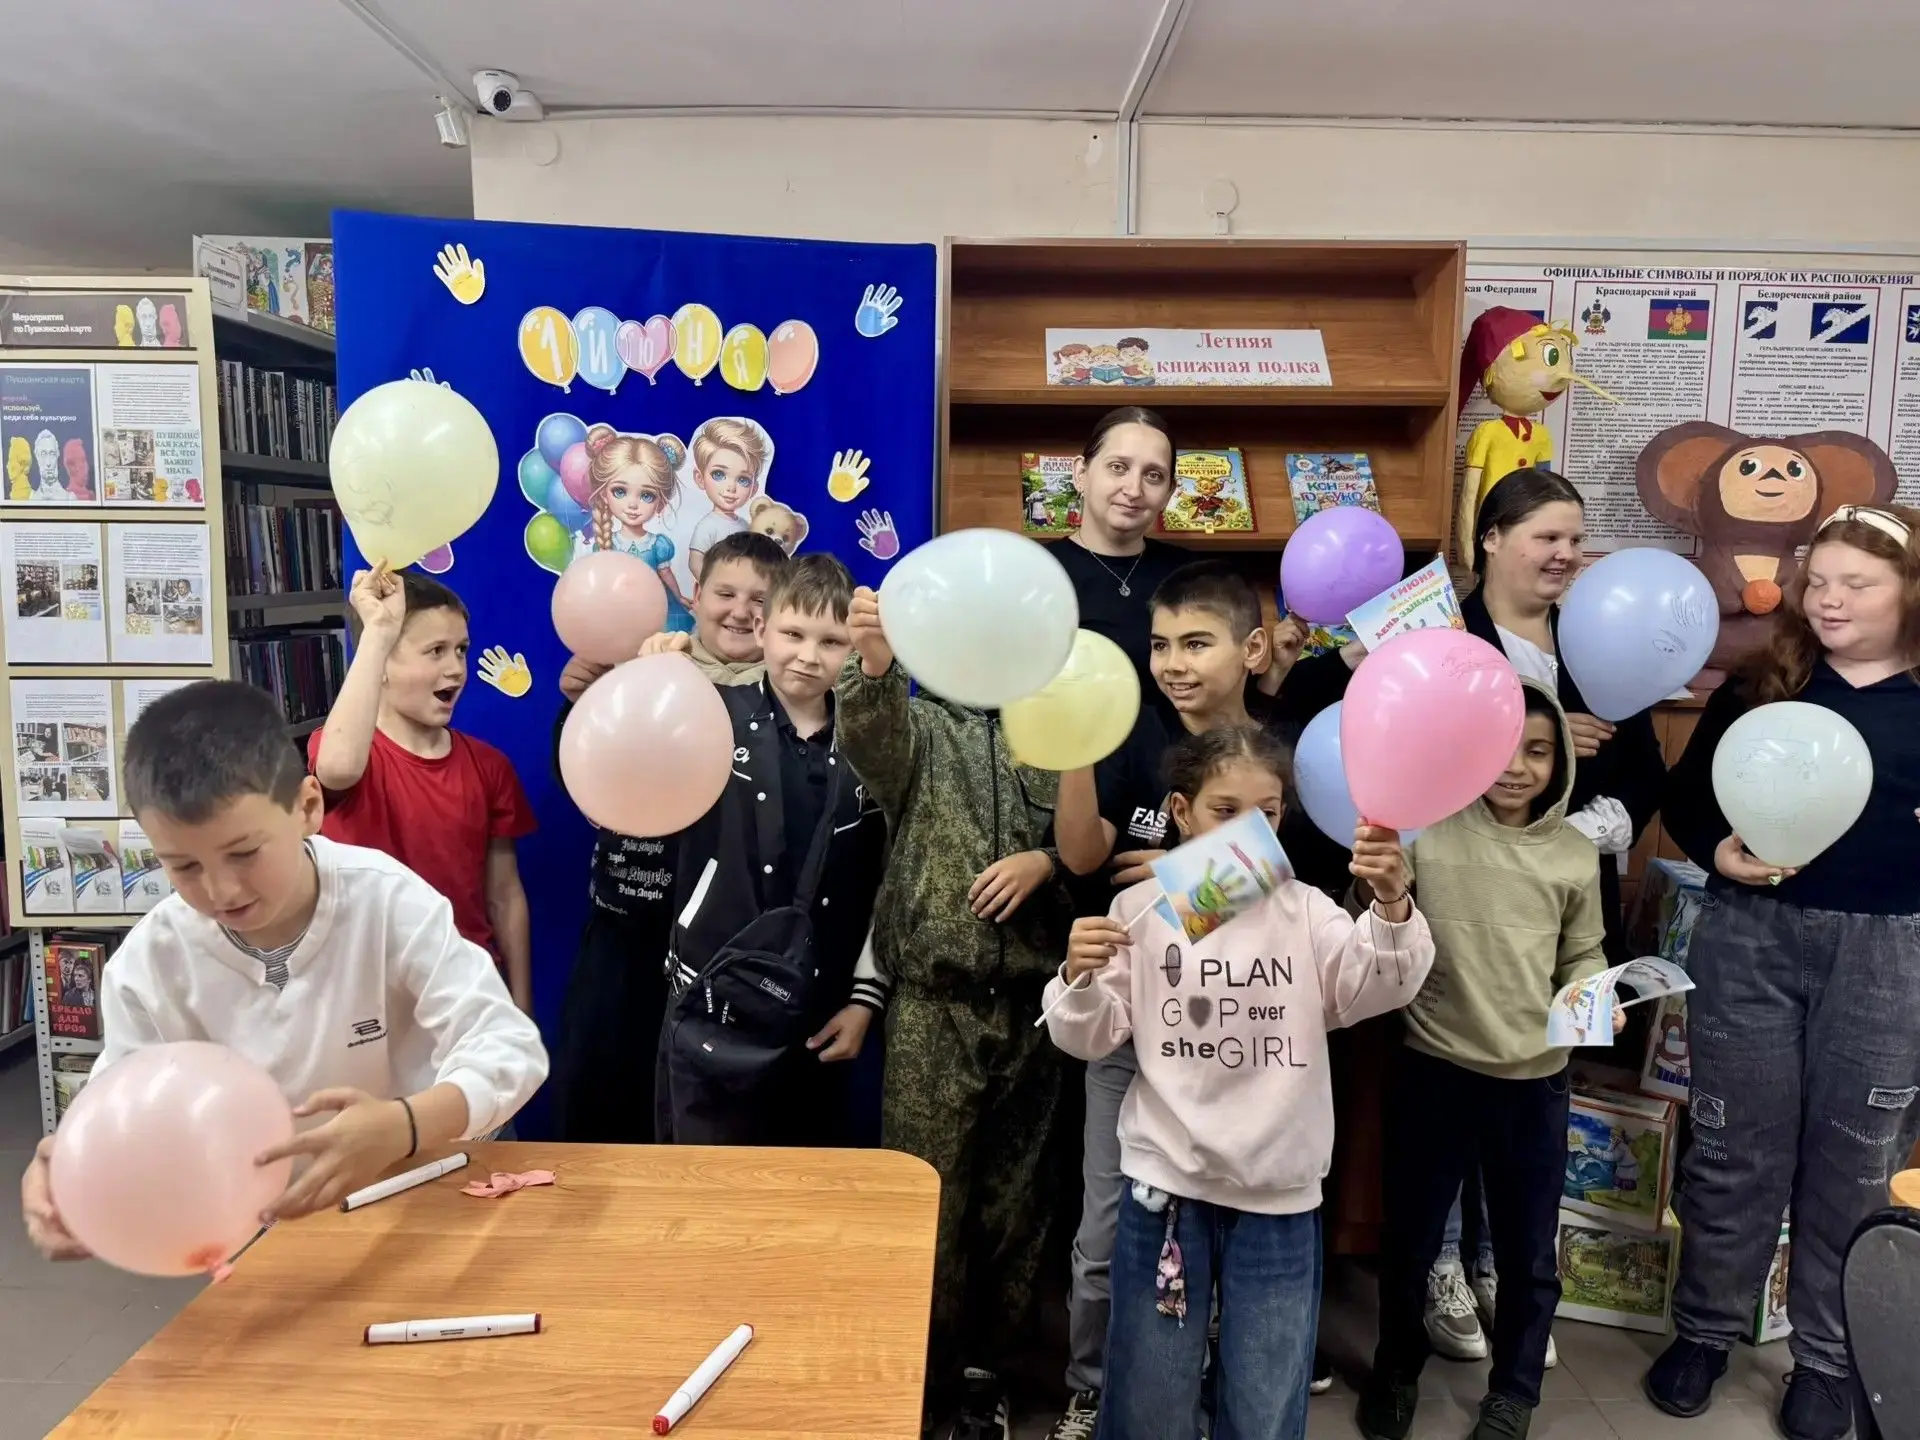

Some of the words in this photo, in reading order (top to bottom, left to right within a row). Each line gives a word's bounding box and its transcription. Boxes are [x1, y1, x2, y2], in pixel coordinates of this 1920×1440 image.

[1543, 268, 1644, 280] ОФИЦИАЛЬНЫЕ
[1646, 269, 1713, 281] СИМВОЛЫ
[1716, 271, 1726, 281] И
[1728, 271, 1789, 283] ПОРЯДОК
[1790, 273, 1808, 283] ИХ
[1811, 273, 1914, 285] РАСПОЛОЖЕНИЯ
[1484, 284, 1538, 296] Федерация
[1595, 286, 1670, 298] Краснодарский
[1673, 287, 1697, 298] край
[1757, 289, 1831, 301] Белореченский
[1832, 292, 1862, 302] район
[12, 312, 64, 323] Мероприятия
[13, 325, 23, 333] по
[24, 324, 70, 335] Пушкинской
[70, 326, 93, 335] карте
[540, 314, 565, 380] 1
[1196, 332, 1273, 349] Летняя
[1156, 360, 1251, 374] книжная
[1257, 360, 1321, 374] полка
[1200, 956, 1293, 988] PLAN
[58, 1015, 80, 1023] ДЛЯ
[1248, 1005, 1286, 1021] ever
[53, 1023, 87, 1034] ГЕРОЯ
